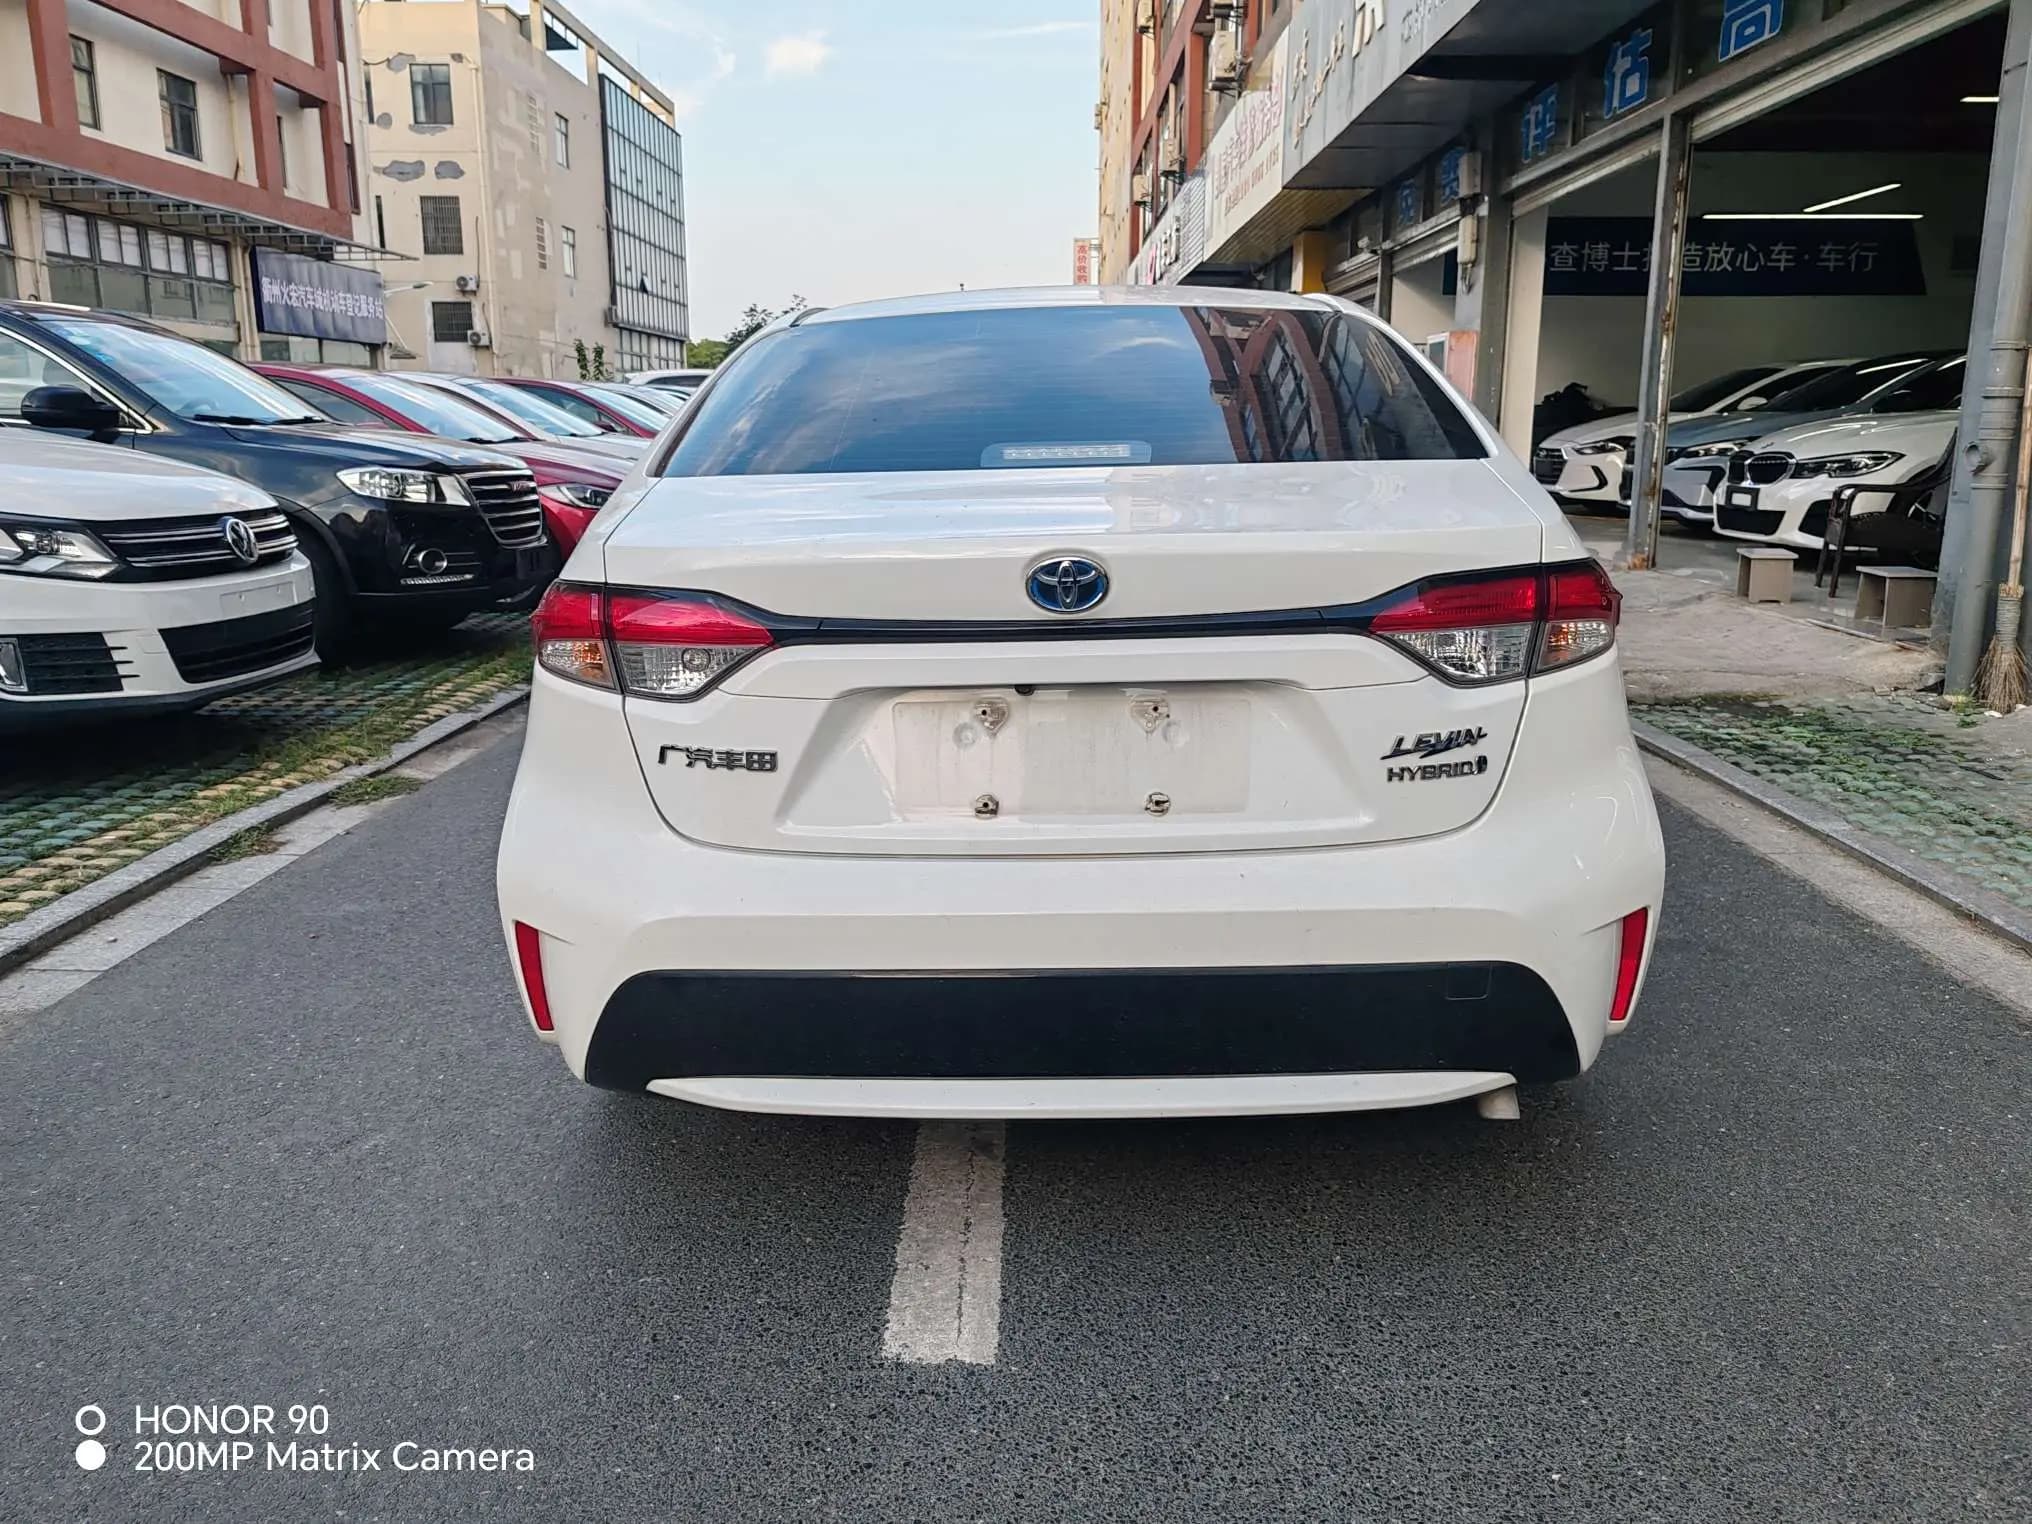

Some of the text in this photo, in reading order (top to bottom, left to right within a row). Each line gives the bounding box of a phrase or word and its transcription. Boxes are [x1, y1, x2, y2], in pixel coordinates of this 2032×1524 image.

[1380, 726, 1488, 760] LEVIN
[658, 745, 778, 772] 广汽丰田
[1387, 760, 1475, 782] HYBRID
